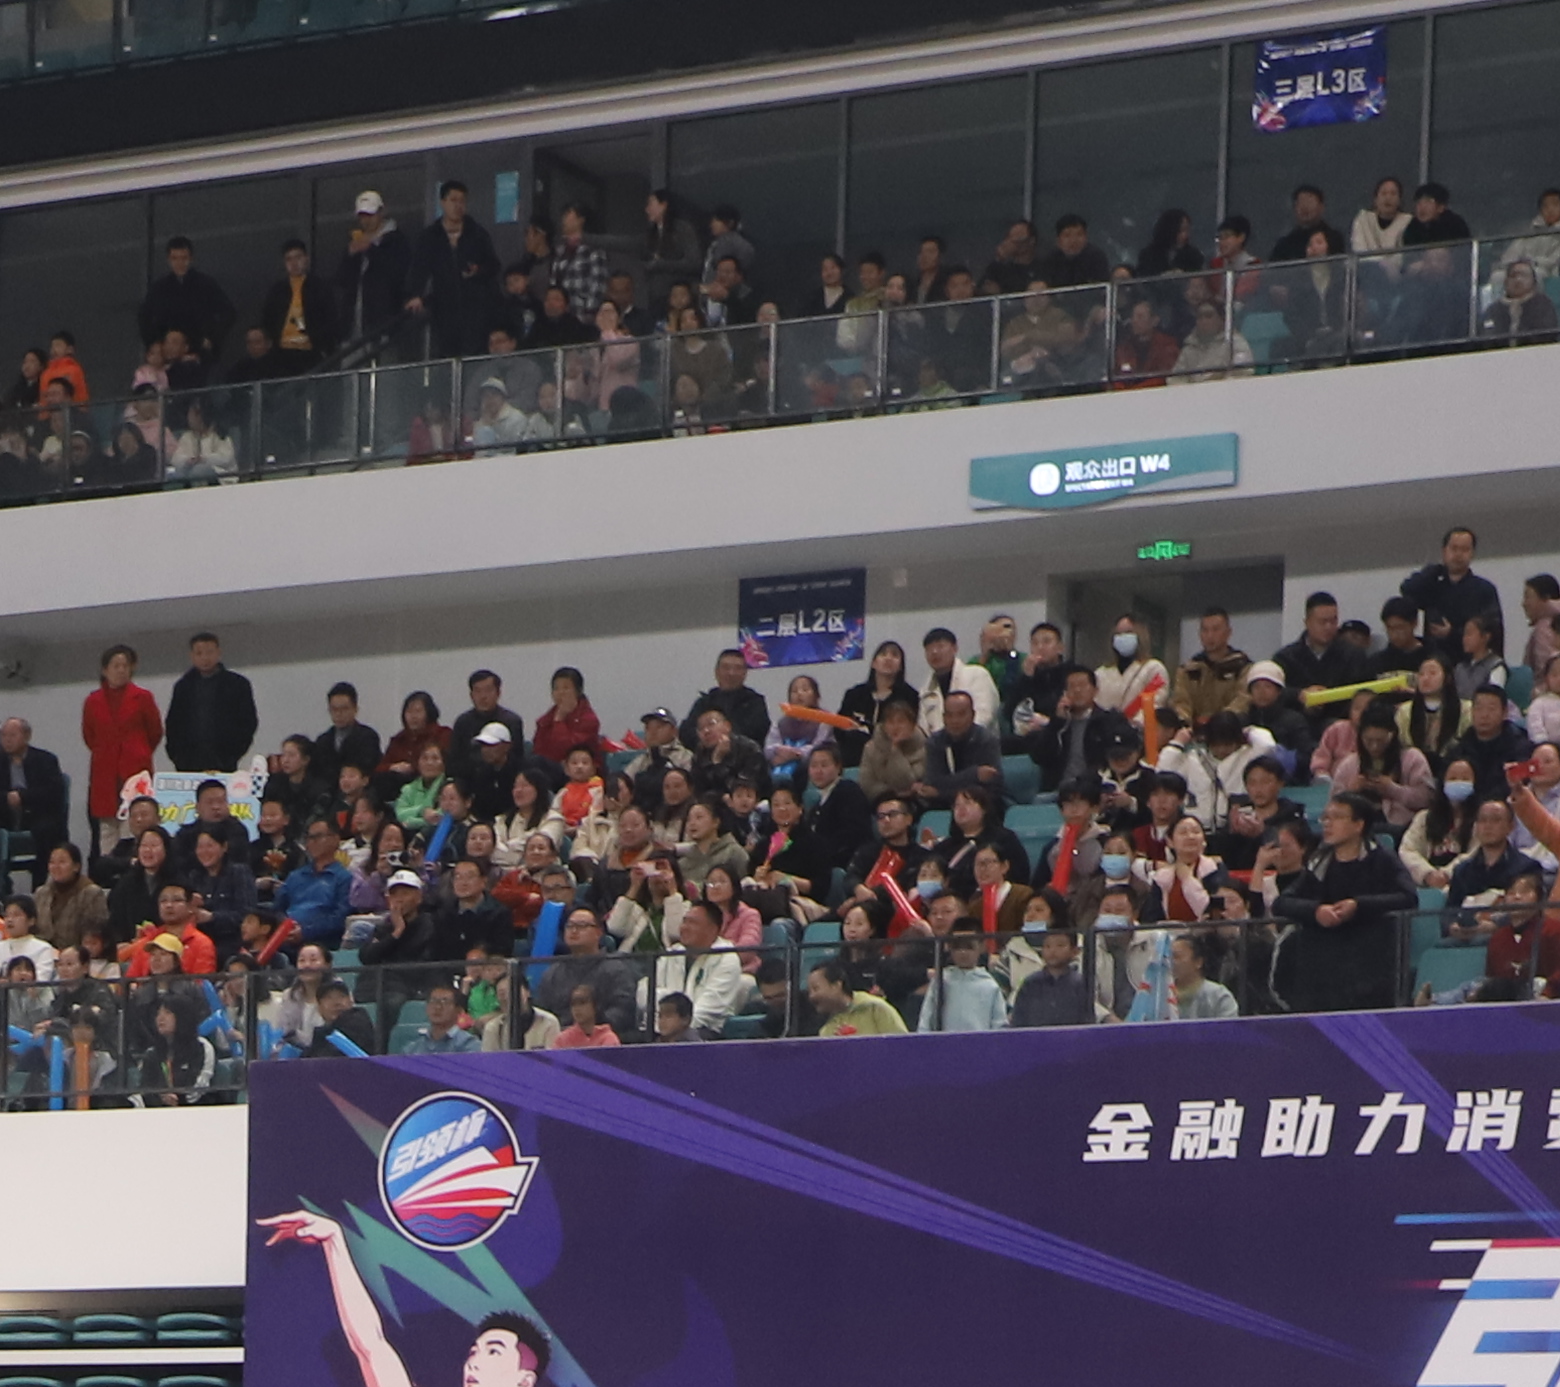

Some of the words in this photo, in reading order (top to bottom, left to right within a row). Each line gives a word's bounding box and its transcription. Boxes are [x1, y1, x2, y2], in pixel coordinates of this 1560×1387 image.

[1064, 456, 1136, 481] 观众出口
[1140, 453, 1170, 473] W4
[756, 608, 846, 637] 二层L2区
